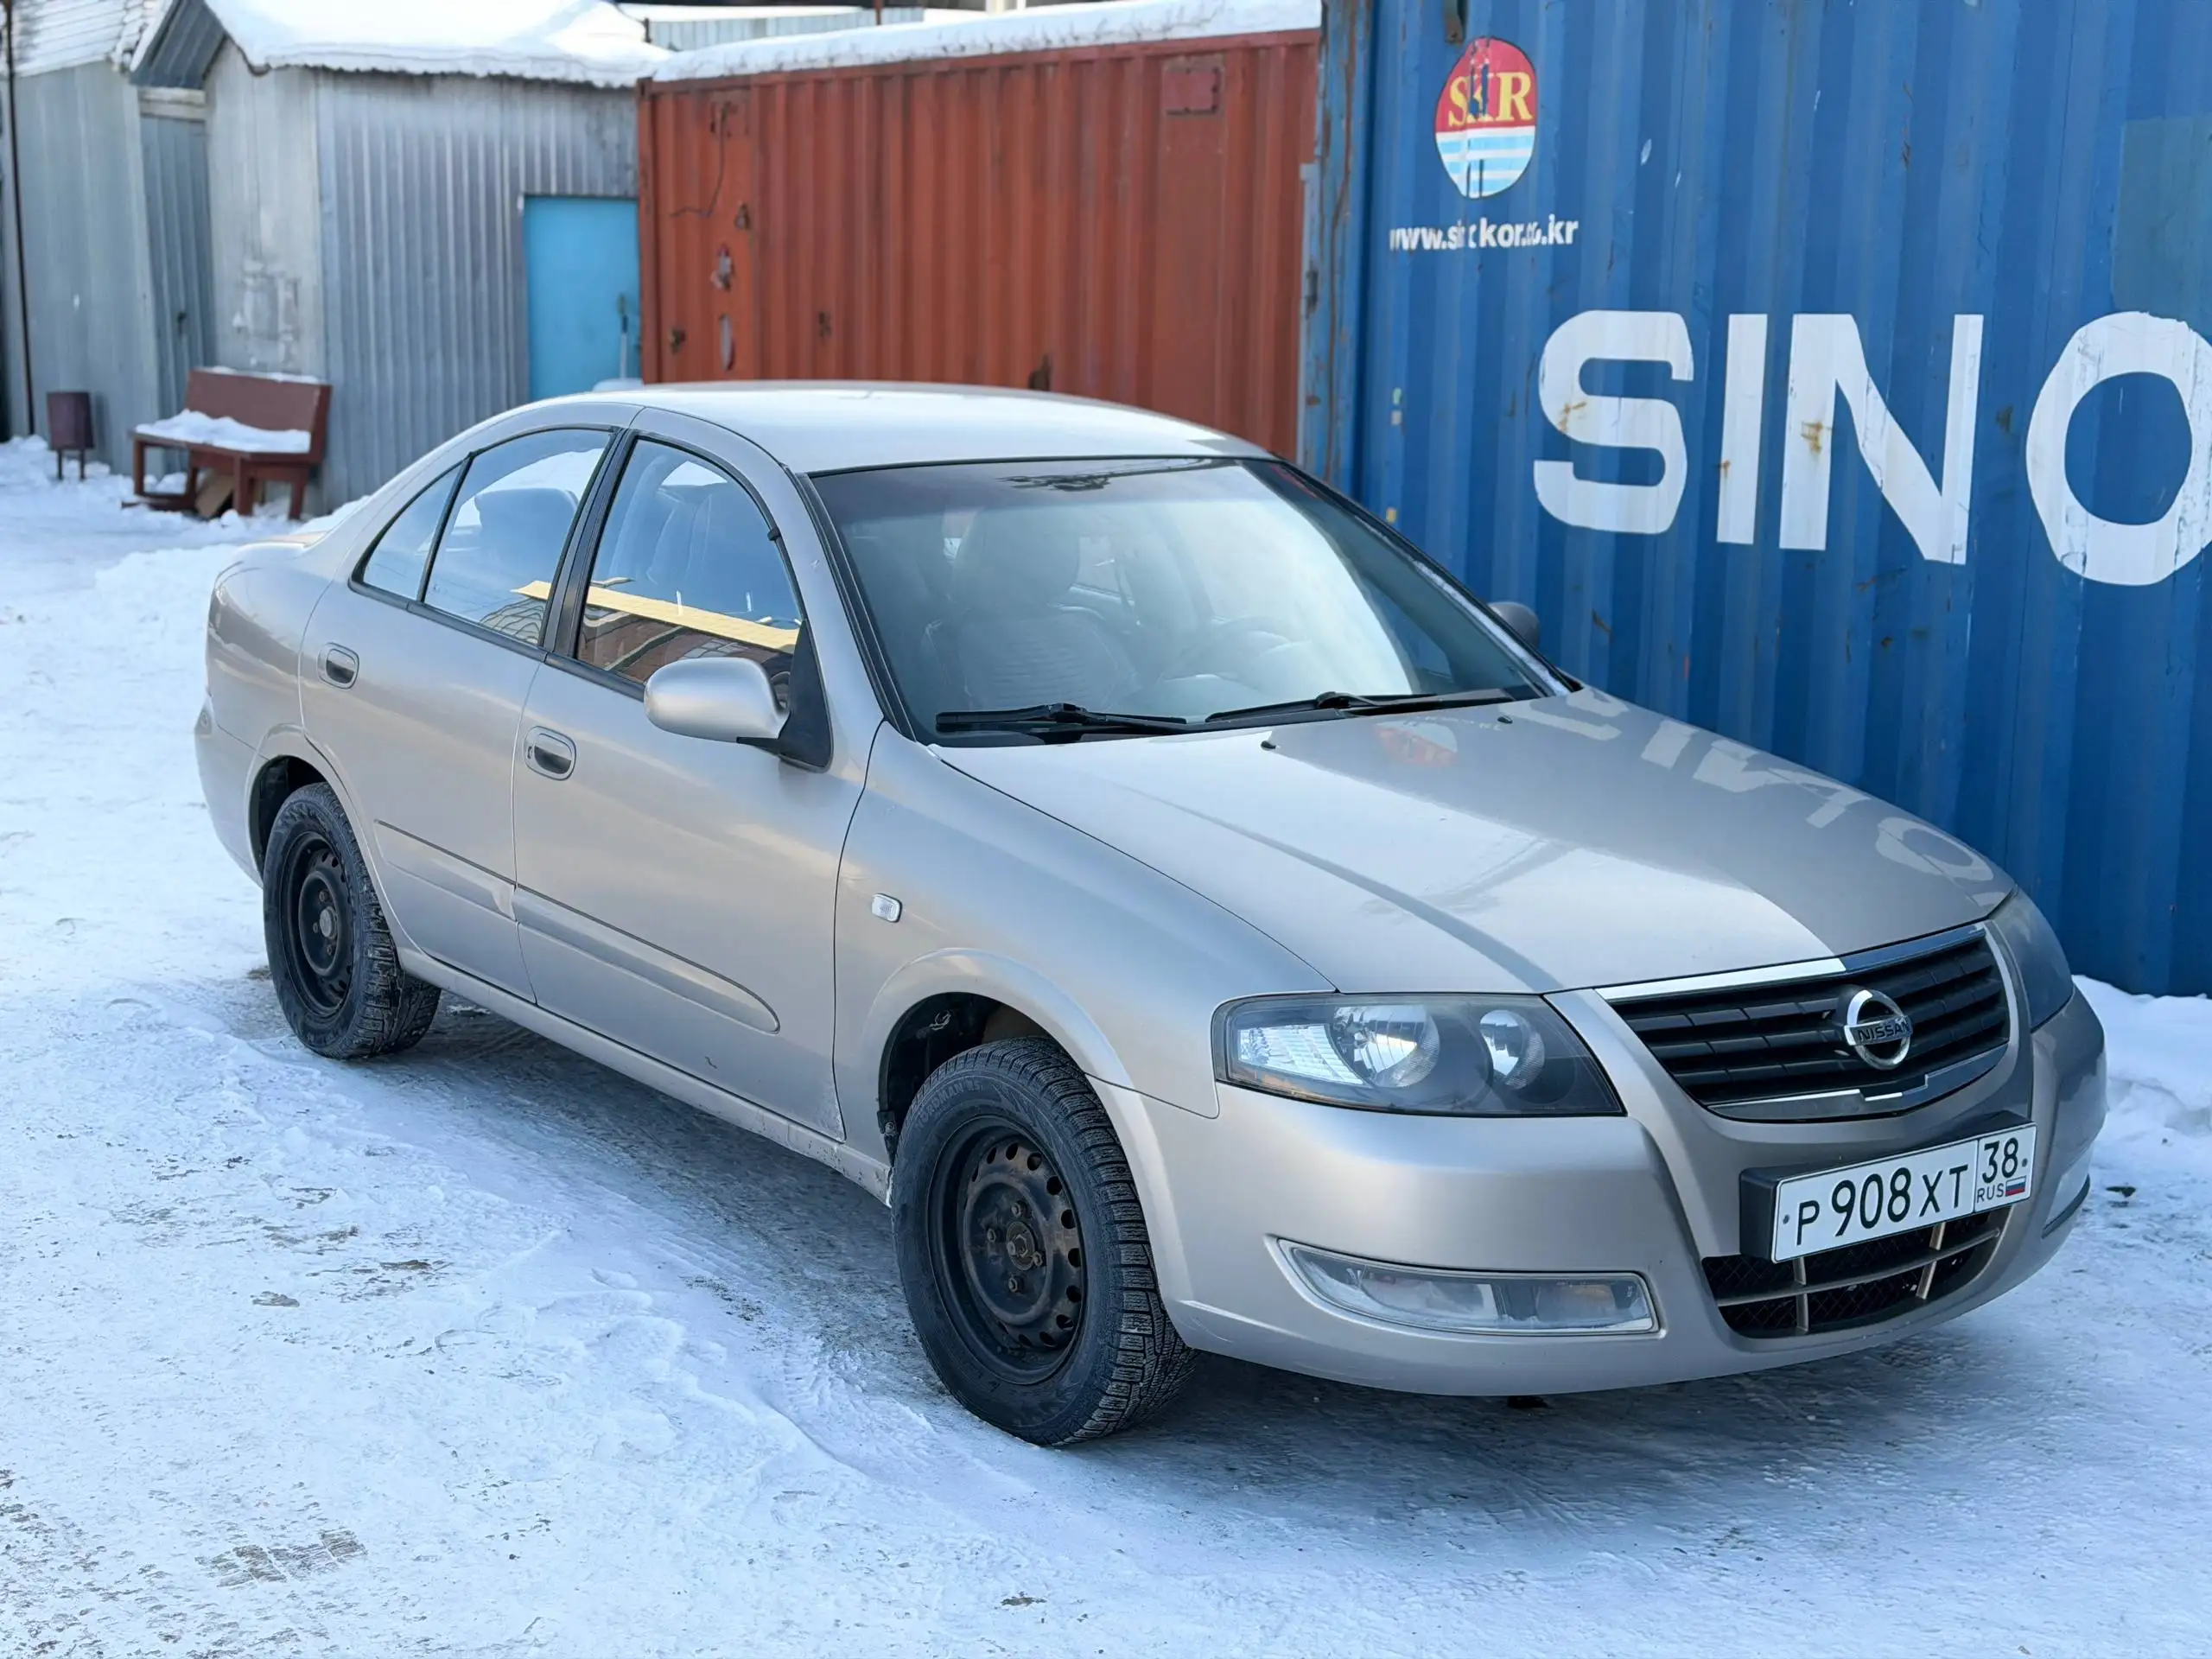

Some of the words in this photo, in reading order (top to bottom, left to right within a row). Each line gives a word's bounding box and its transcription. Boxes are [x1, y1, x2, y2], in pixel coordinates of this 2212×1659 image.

[1533, 309, 2212, 586] SINO
[1857, 1019, 1911, 1042] NISSAN
[1982, 1137, 2018, 1184] 38
[1976, 1180, 2005, 1204] RUS
